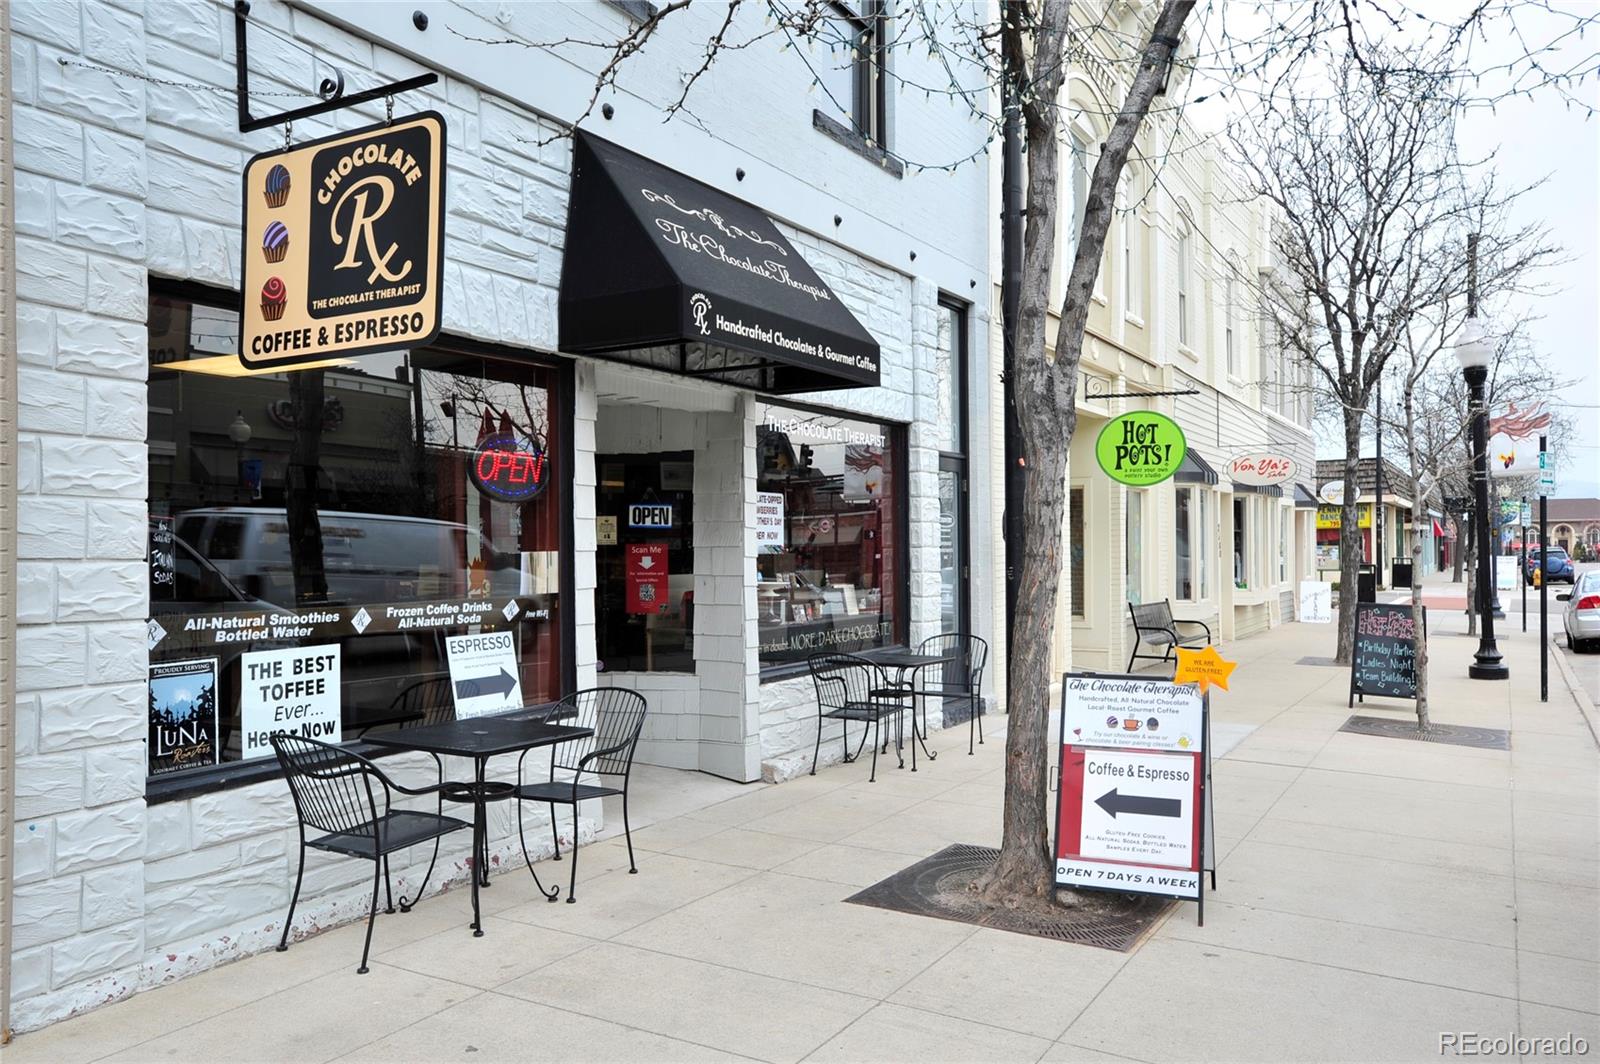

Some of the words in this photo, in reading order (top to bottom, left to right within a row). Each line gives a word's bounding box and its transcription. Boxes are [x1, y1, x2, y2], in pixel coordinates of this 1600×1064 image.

[317, 144, 422, 205] CHOCOLATE
[655, 218, 701, 253] The
[692, 233, 774, 280] Chocolate
[763, 259, 831, 301] Therapist
[312, 299, 327, 310] THE
[329, 292, 375, 308] CHOCOLATE
[376, 284, 421, 299] THERAPIST
[252, 328, 311, 355] COFFEE
[317, 326, 328, 346] &
[334, 312, 424, 344] ESPRESSO
[716, 314, 773, 344] Handcrafted
[774, 332, 817, 356] Chocolates
[818, 345, 824, 358] &
[825, 346, 855, 366] Gourmet
[856, 355, 877, 373] Coffee
[789, 418, 843, 442] CHOCOLATE
[844, 426, 886, 448] THERAPIST
[478, 449, 545, 483] OPEN
[632, 507, 669, 525] OPEN
[632, 546, 648, 554] Scan
[650, 546, 662, 554] Me
[386, 606, 424, 618] Frozen
[426, 603, 459, 616] Coffee
[462, 602, 493, 613] Drinks
[184, 614, 265, 631] All-Natural
[269, 611, 340, 626] Smoothies
[398, 616, 453, 629] All-Natural
[456, 614, 482, 624] Soda
[215, 629, 269, 643] Bottled
[272, 626, 314, 640] Water
[450, 635, 511, 655] ESPRESSO
[1363, 640, 1391, 658] Birthday
[1393, 643, 1416, 657] Parties
[154, 666, 183, 675] PROUDLY
[184, 663, 210, 672] SERVING
[248, 661, 282, 680] THE
[292, 655, 335, 675] BEST
[1362, 655, 1386, 668] Ladies
[1361, 669, 1380, 681] Team
[1381, 670, 1415, 687] Building!
[259, 679, 325, 702] TOFFEE
[1069, 679, 1089, 691] The
[1091, 679, 1142, 694] Chocolate
[1143, 681, 1195, 700] Therapist
[1156, 698, 1189, 706] Chocolate
[1088, 761, 1124, 776] Coffee
[1127, 764, 1135, 777] &
[1137, 766, 1190, 783] Espresso
[1106, 844, 1130, 852] SAMPLES
[1143, 840, 1167, 848] BOTTLED
[1057, 866, 1092, 879] OPEN
[1097, 870, 1104, 879] 7
[1106, 871, 1142, 884] DAYS
[1146, 875, 1155, 884] A
[1158, 876, 1197, 889] WEEK
